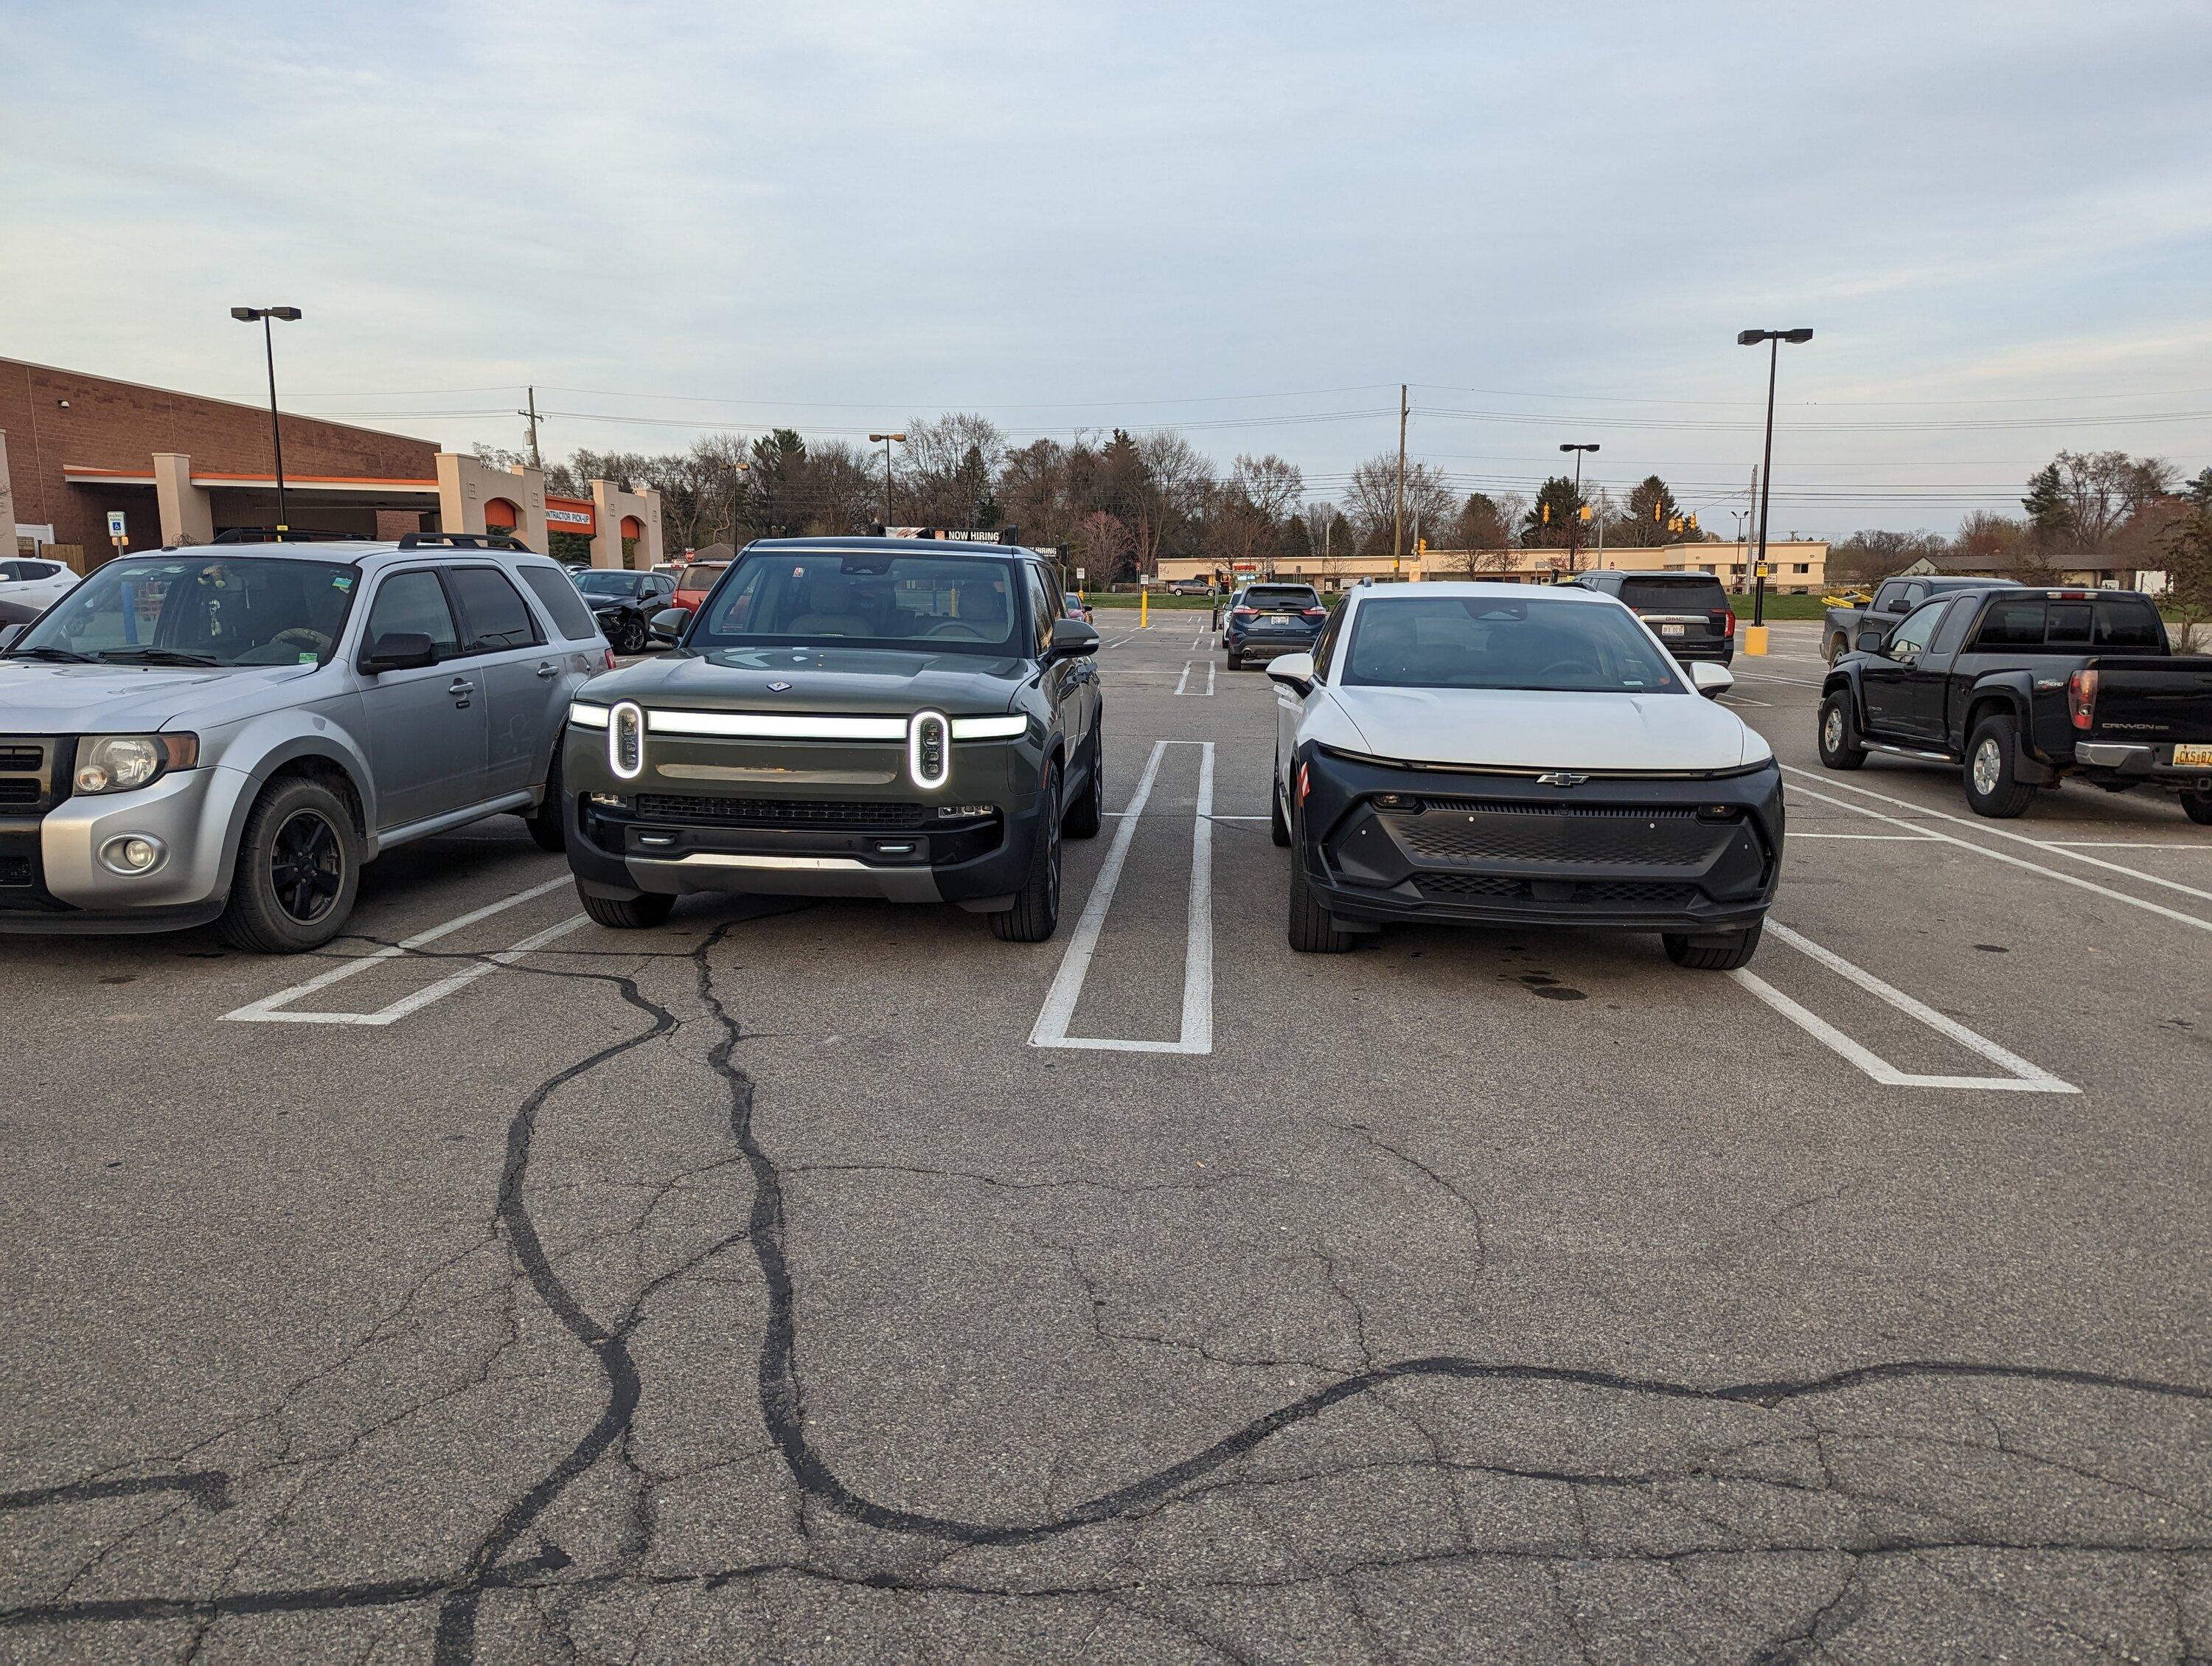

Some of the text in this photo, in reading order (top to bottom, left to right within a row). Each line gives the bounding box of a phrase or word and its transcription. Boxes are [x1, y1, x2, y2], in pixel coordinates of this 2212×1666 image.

[572, 513, 589, 523] PICK-UP
[949, 531, 999, 541] NOW HIRING
[1035, 546, 1057, 555] HIRING
[2180, 751, 2196, 763] CKS
